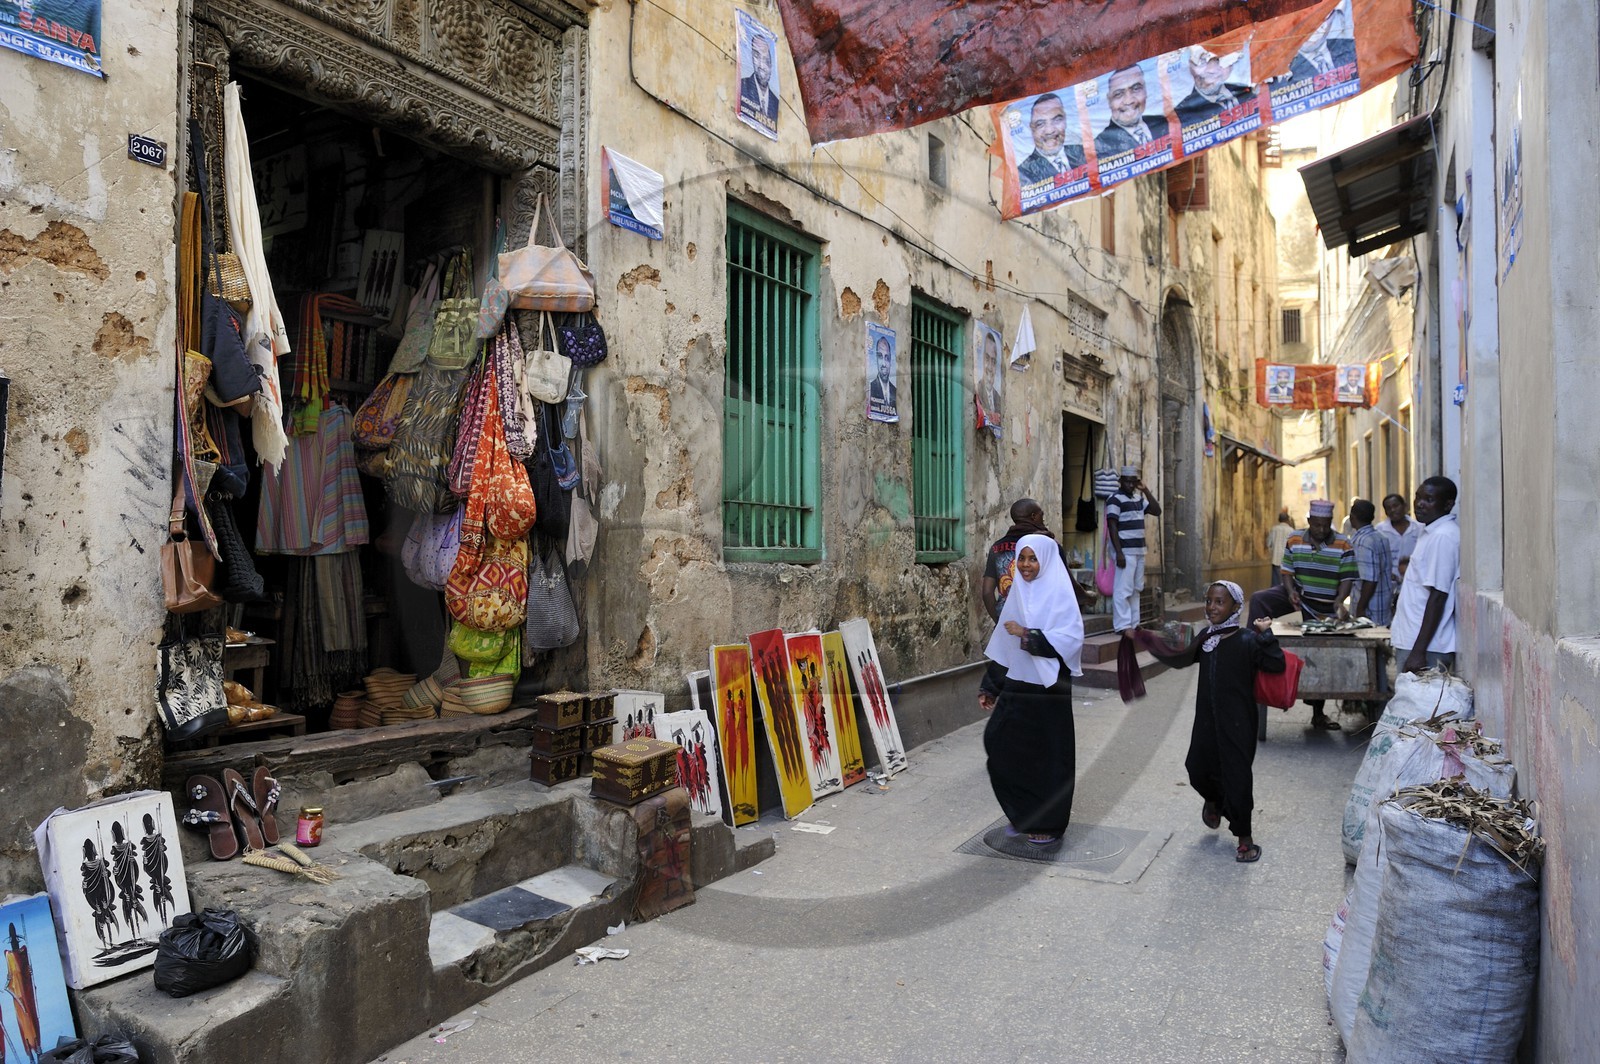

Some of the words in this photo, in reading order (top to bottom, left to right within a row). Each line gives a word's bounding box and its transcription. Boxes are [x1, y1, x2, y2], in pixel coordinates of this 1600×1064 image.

[18, 11, 96, 53] SANYA
[1271, 84, 1314, 107] MAALIM
[1313, 62, 1357, 92] SEIF
[1275, 101, 1306, 119] RAIS
[1309, 83, 1358, 108] MAKINI
[755, 111, 776, 131] JUSSA
[1183, 121, 1220, 142] MAALIM
[1219, 98, 1260, 127] SEIF
[1184, 136, 1213, 154] RAIS
[1216, 117, 1261, 141] MAKINI
[133, 141, 162, 159] 2067
[1098, 154, 1135, 173] MAALIM
[1134, 134, 1172, 160] SEIF
[1021, 182, 1055, 198] MAALIM
[1054, 164, 1089, 187] SEIF
[1101, 169, 1129, 186] RAIS
[1131, 152, 1174, 174] MAKINI
[1022, 195, 1047, 212] RAIS
[1049, 181, 1089, 201] MAKINI
[880, 405, 897, 415] JUSSA
